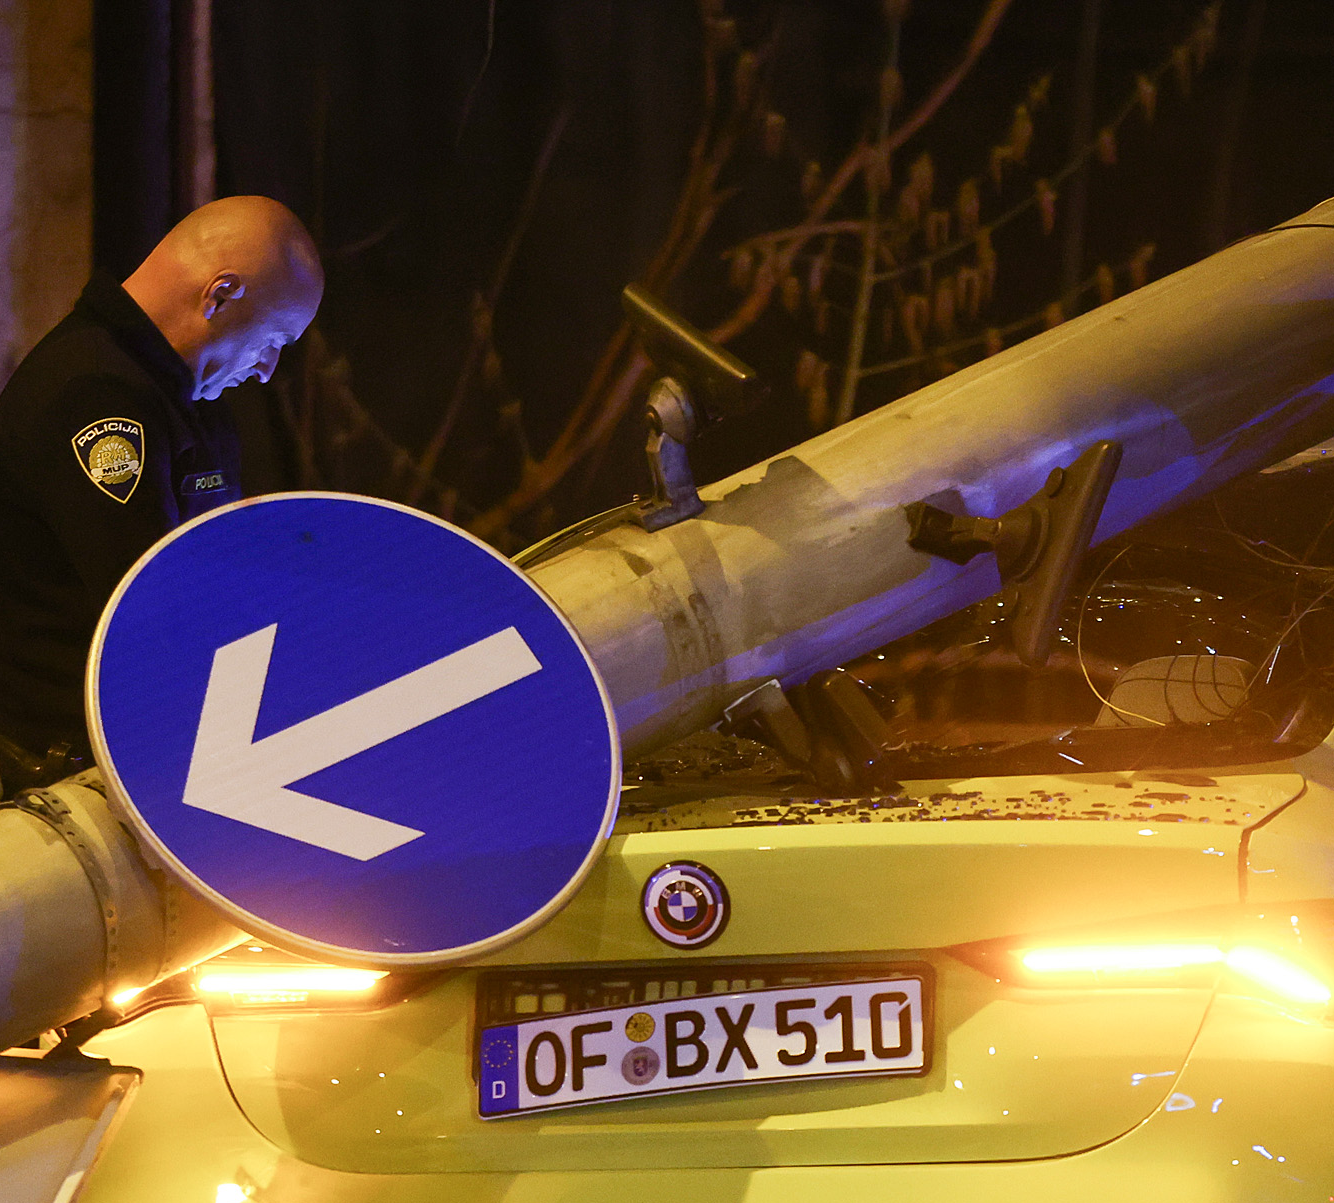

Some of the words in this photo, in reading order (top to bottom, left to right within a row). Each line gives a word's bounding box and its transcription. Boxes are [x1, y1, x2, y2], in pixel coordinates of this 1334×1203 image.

[77, 422, 139, 447] POLICIJA
[102, 463, 130, 475] MUP
[661, 881, 703, 899] BMW
[524, 1020, 613, 1097] OF
[664, 1002, 760, 1079] BX
[775, 990, 913, 1066] 510
[492, 1080, 506, 1099] D
